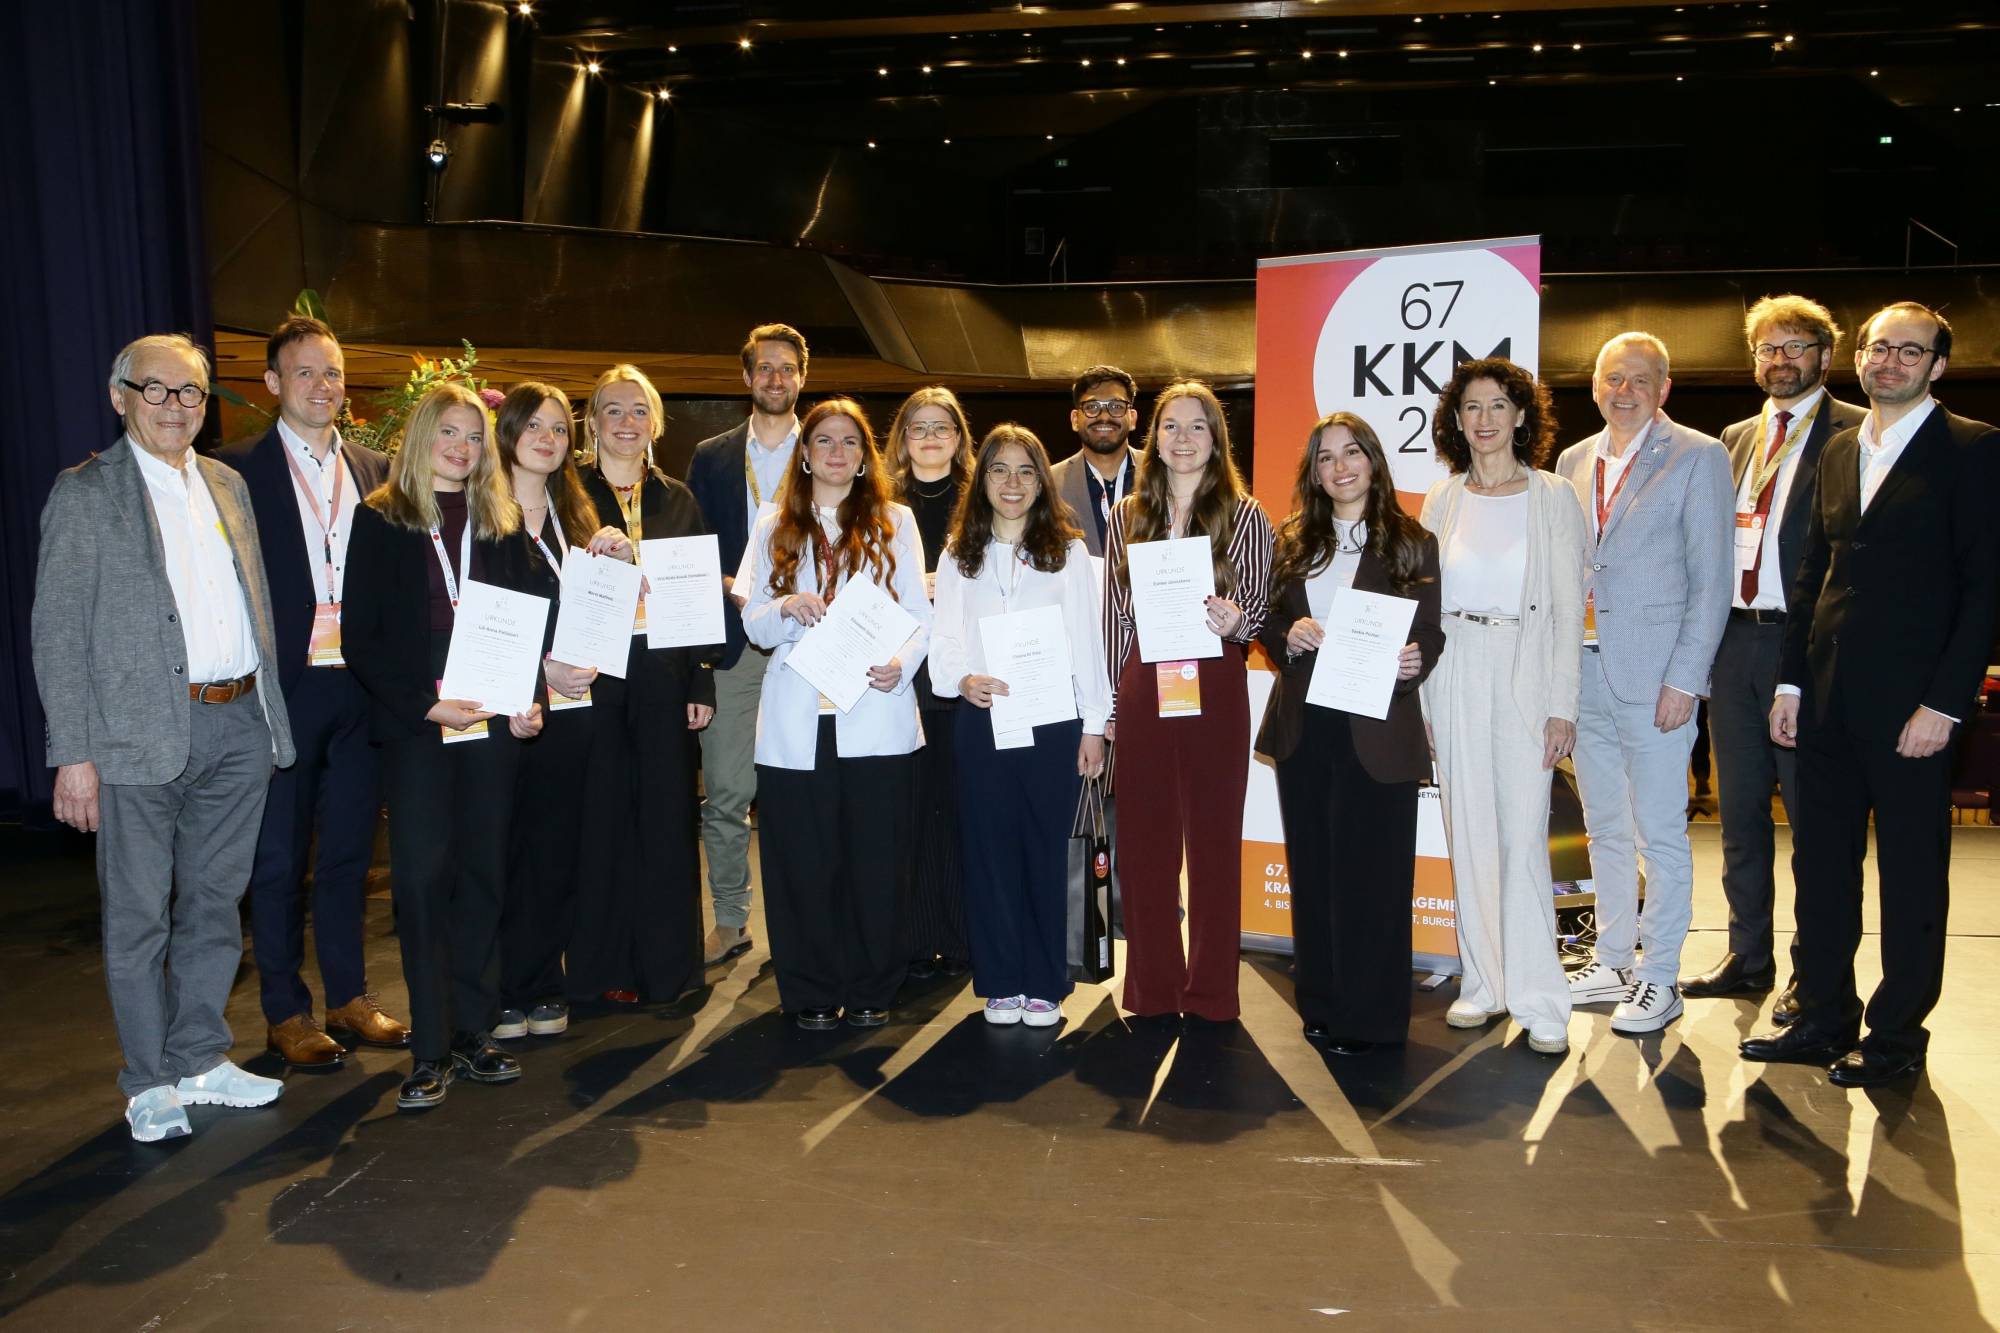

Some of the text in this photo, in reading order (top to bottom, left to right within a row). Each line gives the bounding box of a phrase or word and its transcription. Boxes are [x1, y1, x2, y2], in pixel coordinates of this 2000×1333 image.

[1400, 280, 1464, 330] 67
[1265, 863, 1288, 877] 67.
[1264, 899, 1290, 910] 4. BIS
